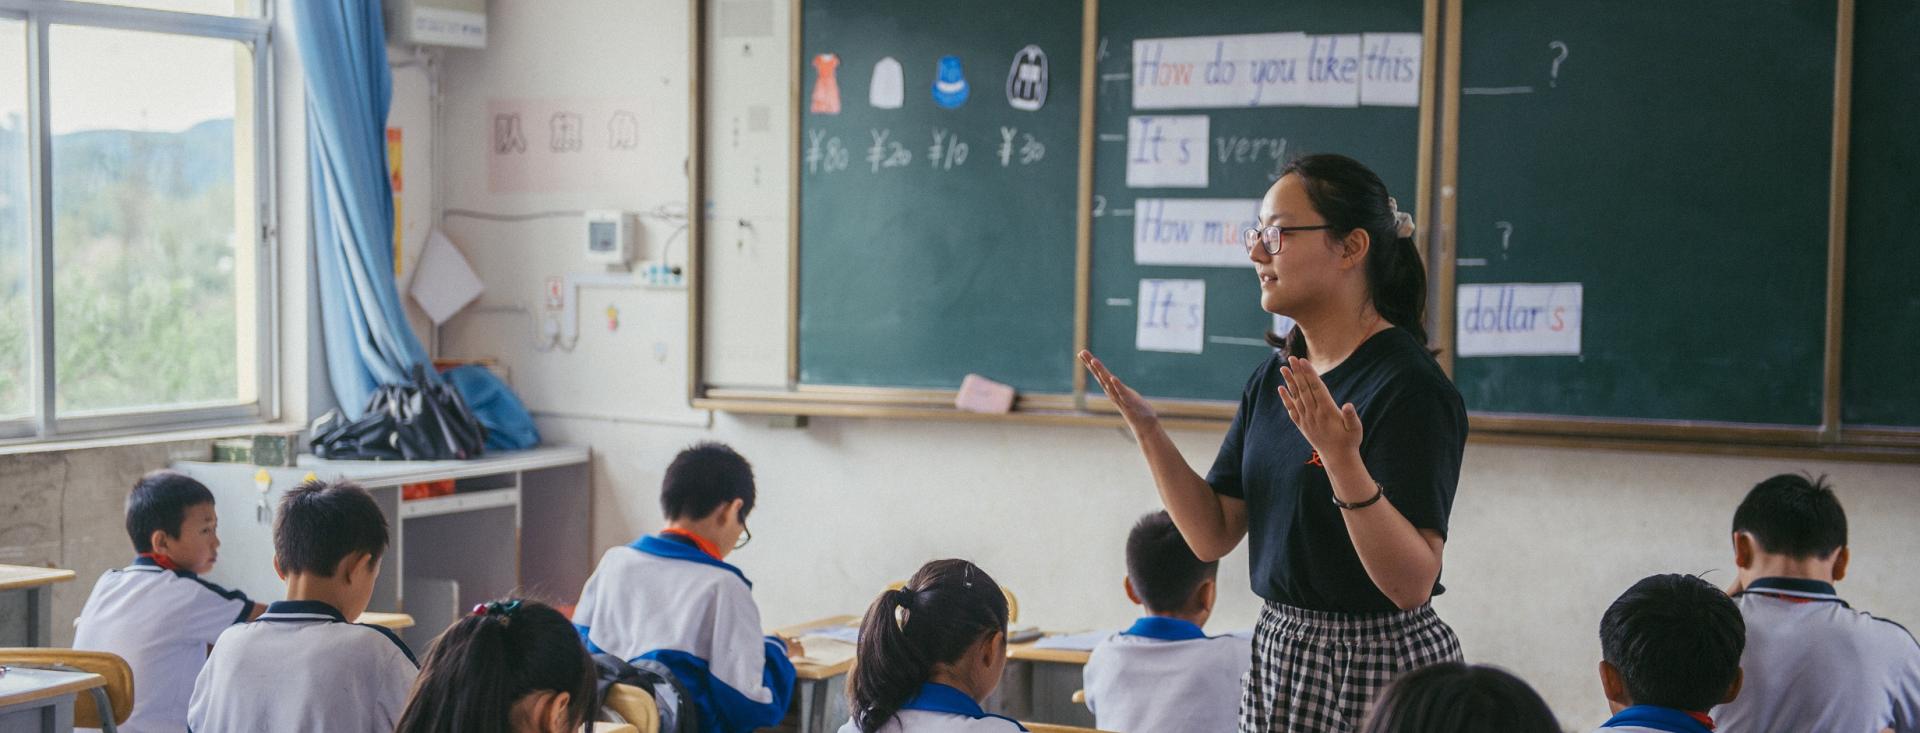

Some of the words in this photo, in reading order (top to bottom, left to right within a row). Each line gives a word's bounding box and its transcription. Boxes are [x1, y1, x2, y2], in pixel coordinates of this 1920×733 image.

[1137, 43, 1193, 86] How
[1204, 40, 1237, 85] do
[1250, 57, 1297, 106] you
[1307, 34, 1357, 84] like
[1364, 37, 1412, 82] this
[866, 128, 913, 174] ¥20
[927, 128, 969, 171] ¥10
[997, 125, 1046, 168] ¥30
[1216, 135, 1287, 182] very
[1141, 200, 1191, 243] How
